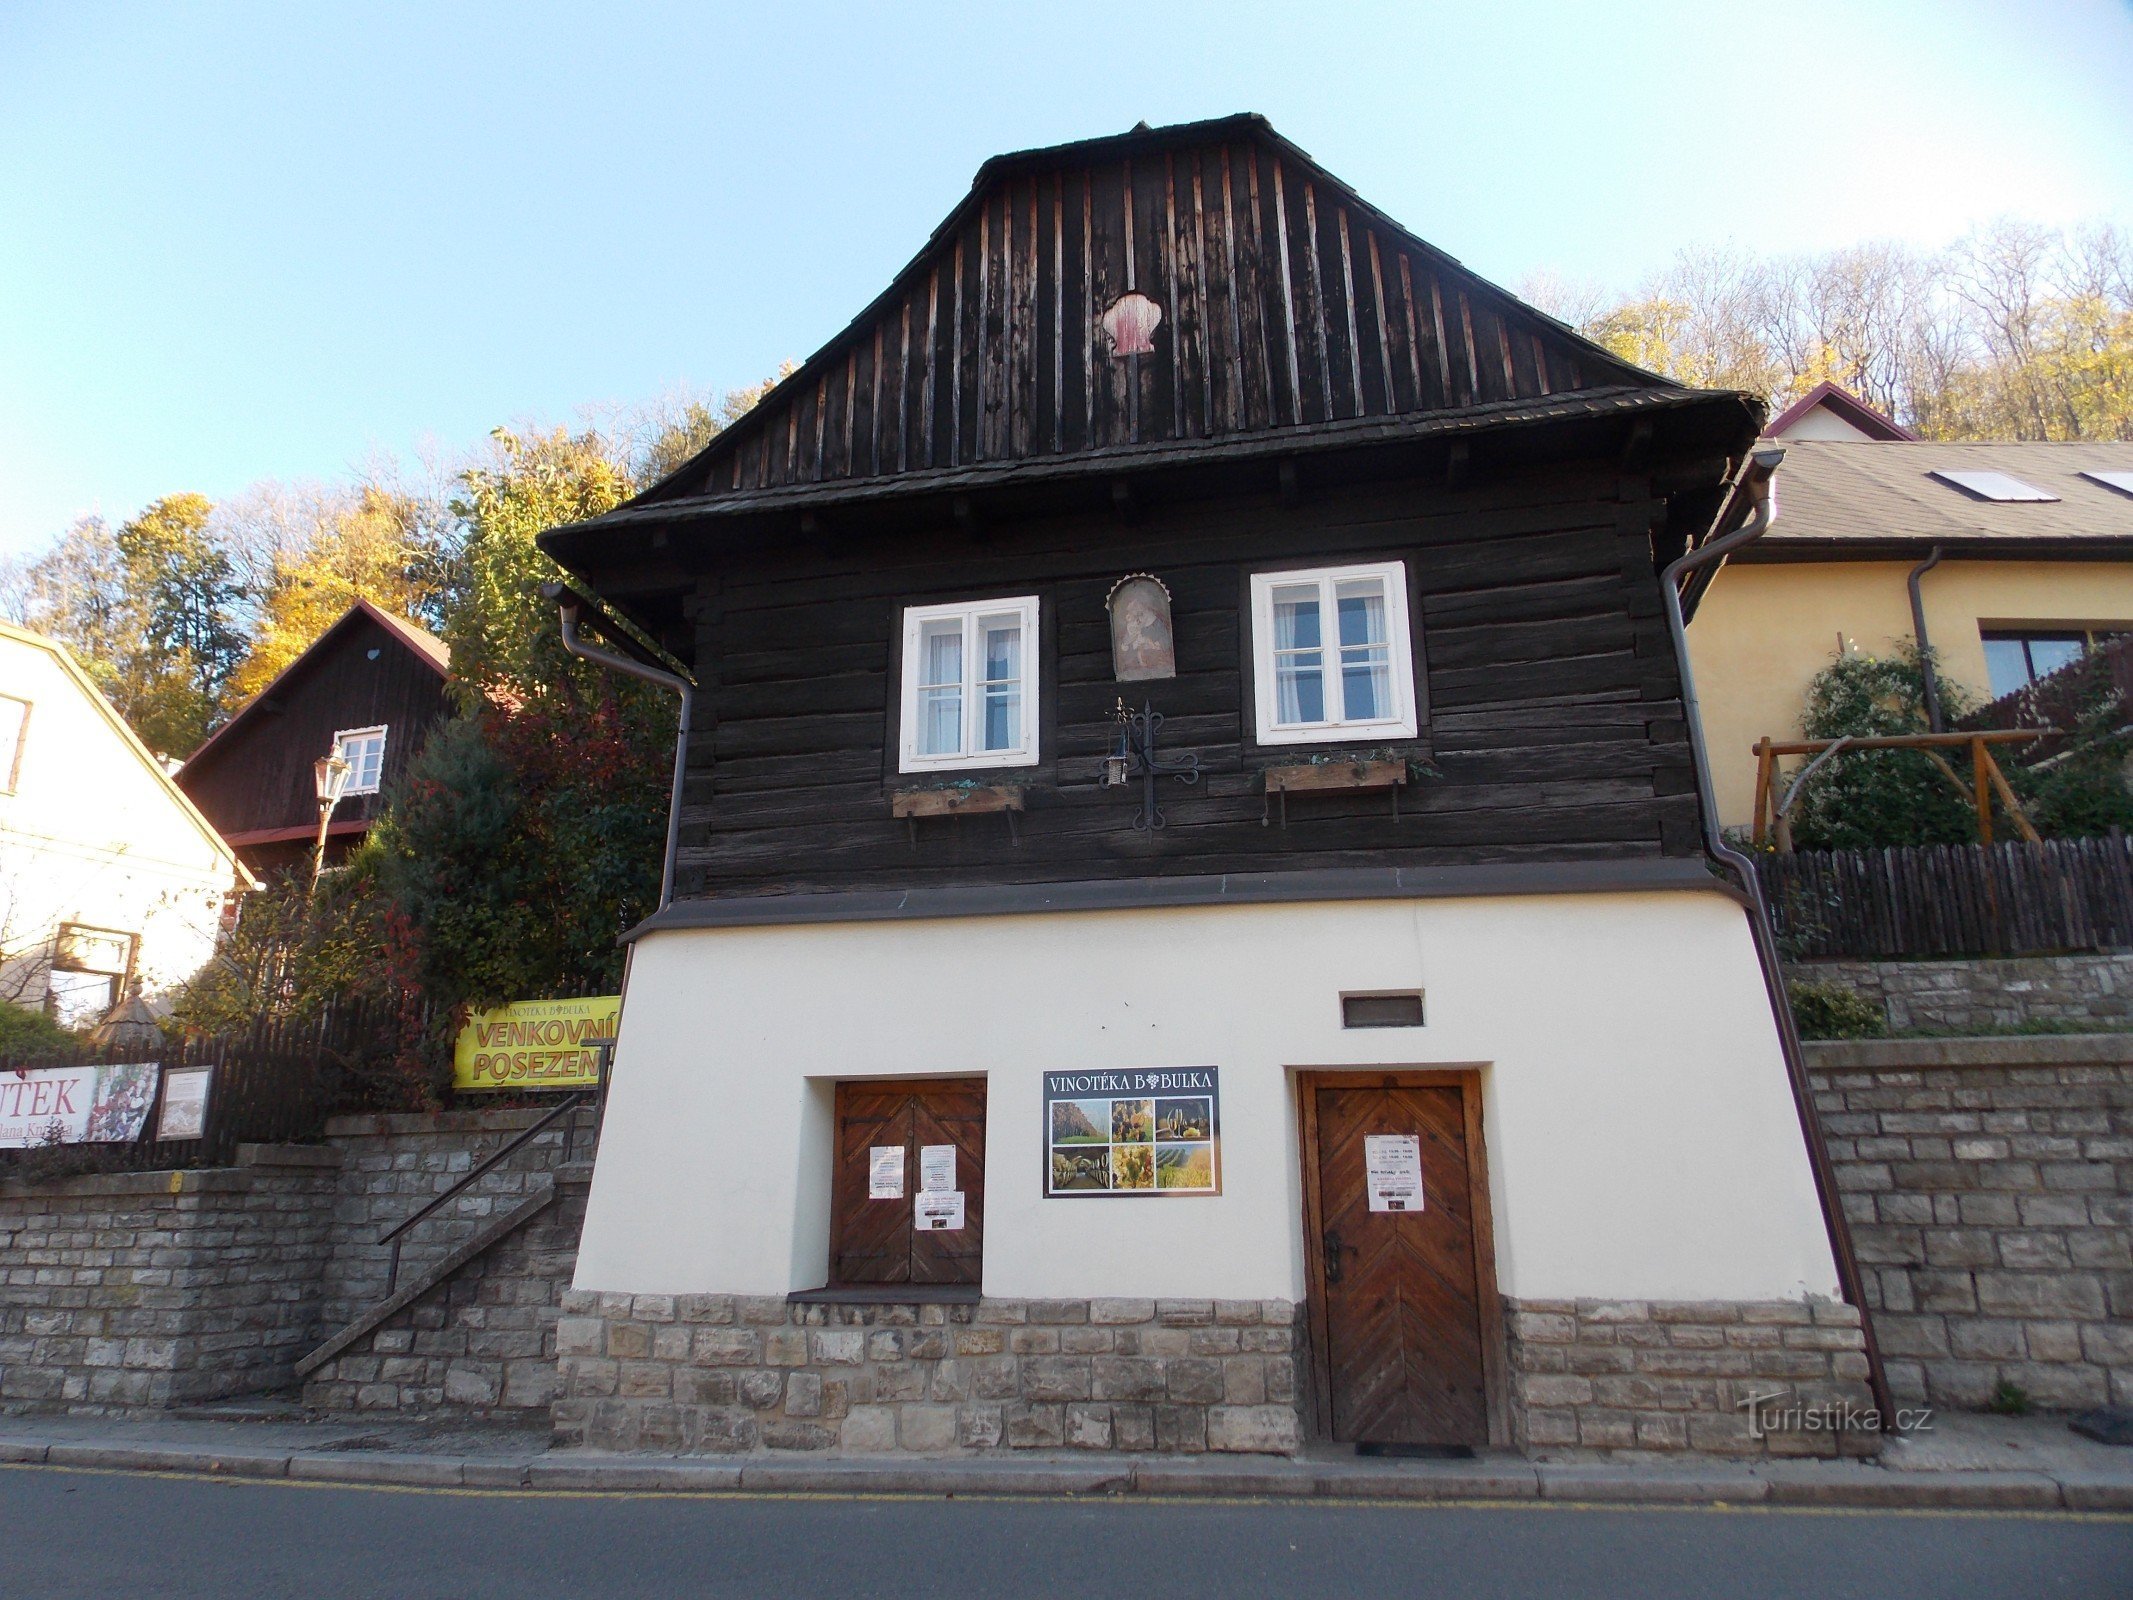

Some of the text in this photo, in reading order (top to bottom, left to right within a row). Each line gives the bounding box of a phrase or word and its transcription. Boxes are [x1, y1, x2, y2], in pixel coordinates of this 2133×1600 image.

[476, 1012, 617, 1047] VENKOVNÍ
[0, 1080, 79, 1117] TEK
[1049, 1073, 1130, 1092] VINOTÉKA
